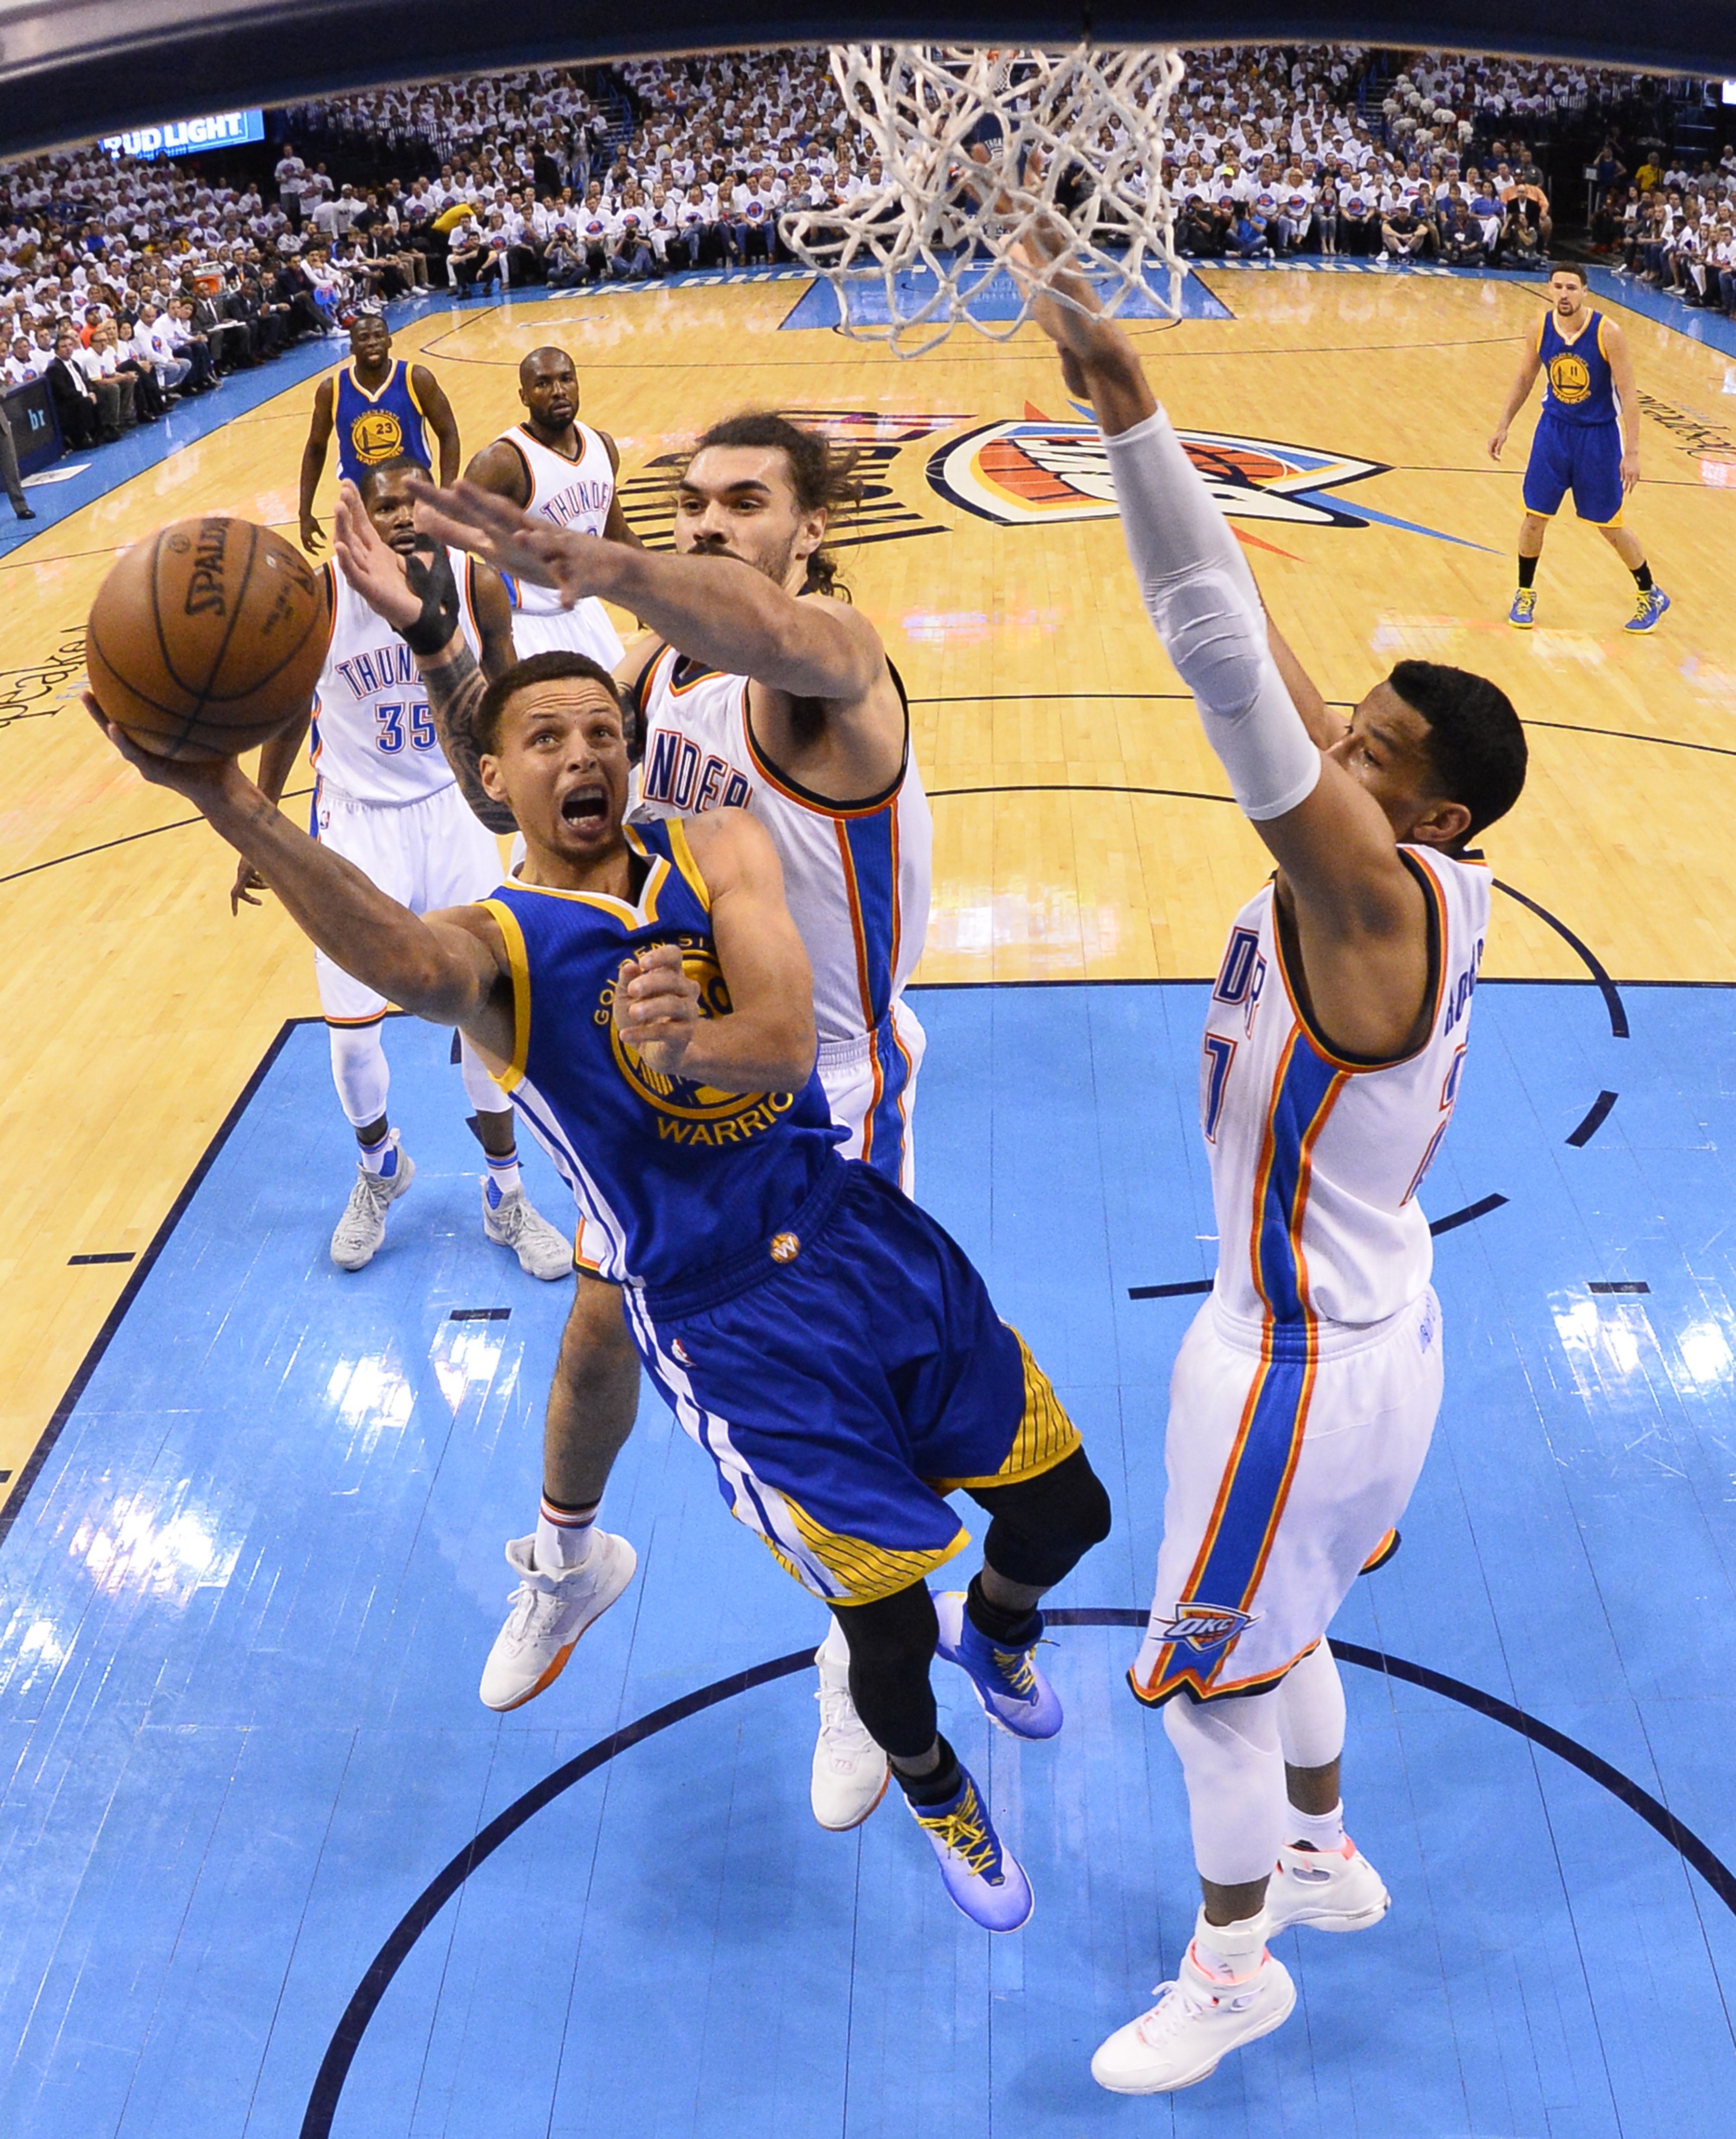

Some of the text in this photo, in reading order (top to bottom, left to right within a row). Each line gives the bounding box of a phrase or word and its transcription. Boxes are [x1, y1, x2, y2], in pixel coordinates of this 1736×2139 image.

[163, 113, 242, 148] LIGHT
[1570, 366, 1578, 377] 11
[376, 422, 393, 434] 23
[335, 644, 424, 700] THUN
[375, 701, 438, 755] 35
[1163, 1617, 1234, 1638] OKC
